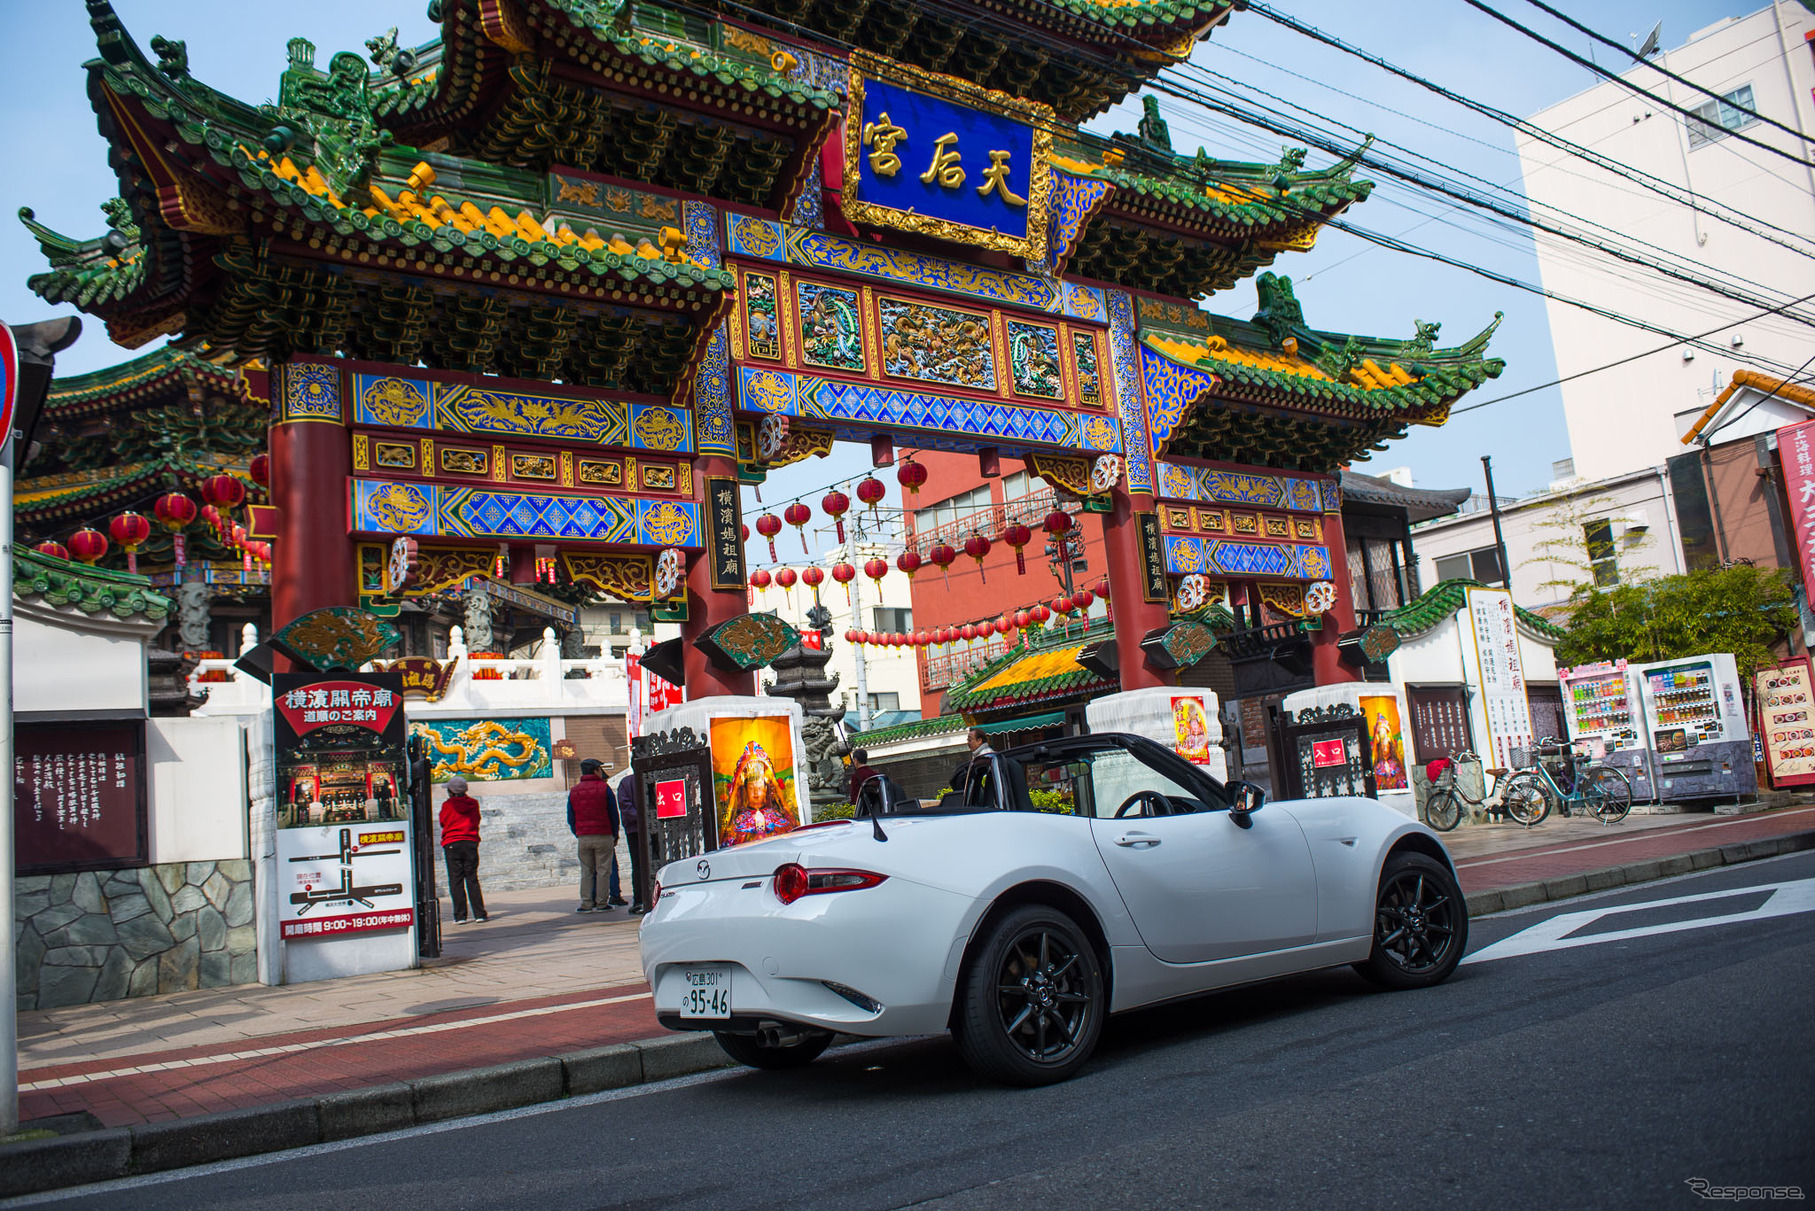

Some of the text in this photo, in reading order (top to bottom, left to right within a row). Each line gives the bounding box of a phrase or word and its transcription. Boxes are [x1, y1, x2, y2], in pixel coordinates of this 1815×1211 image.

[1794, 429, 1813, 475] 上海料理
[303, 709, 377, 723] 道順のご案内
[1315, 747, 1341, 758] 入口
[657, 791, 682, 806] 出口
[683, 989, 727, 1014] の 95-46
